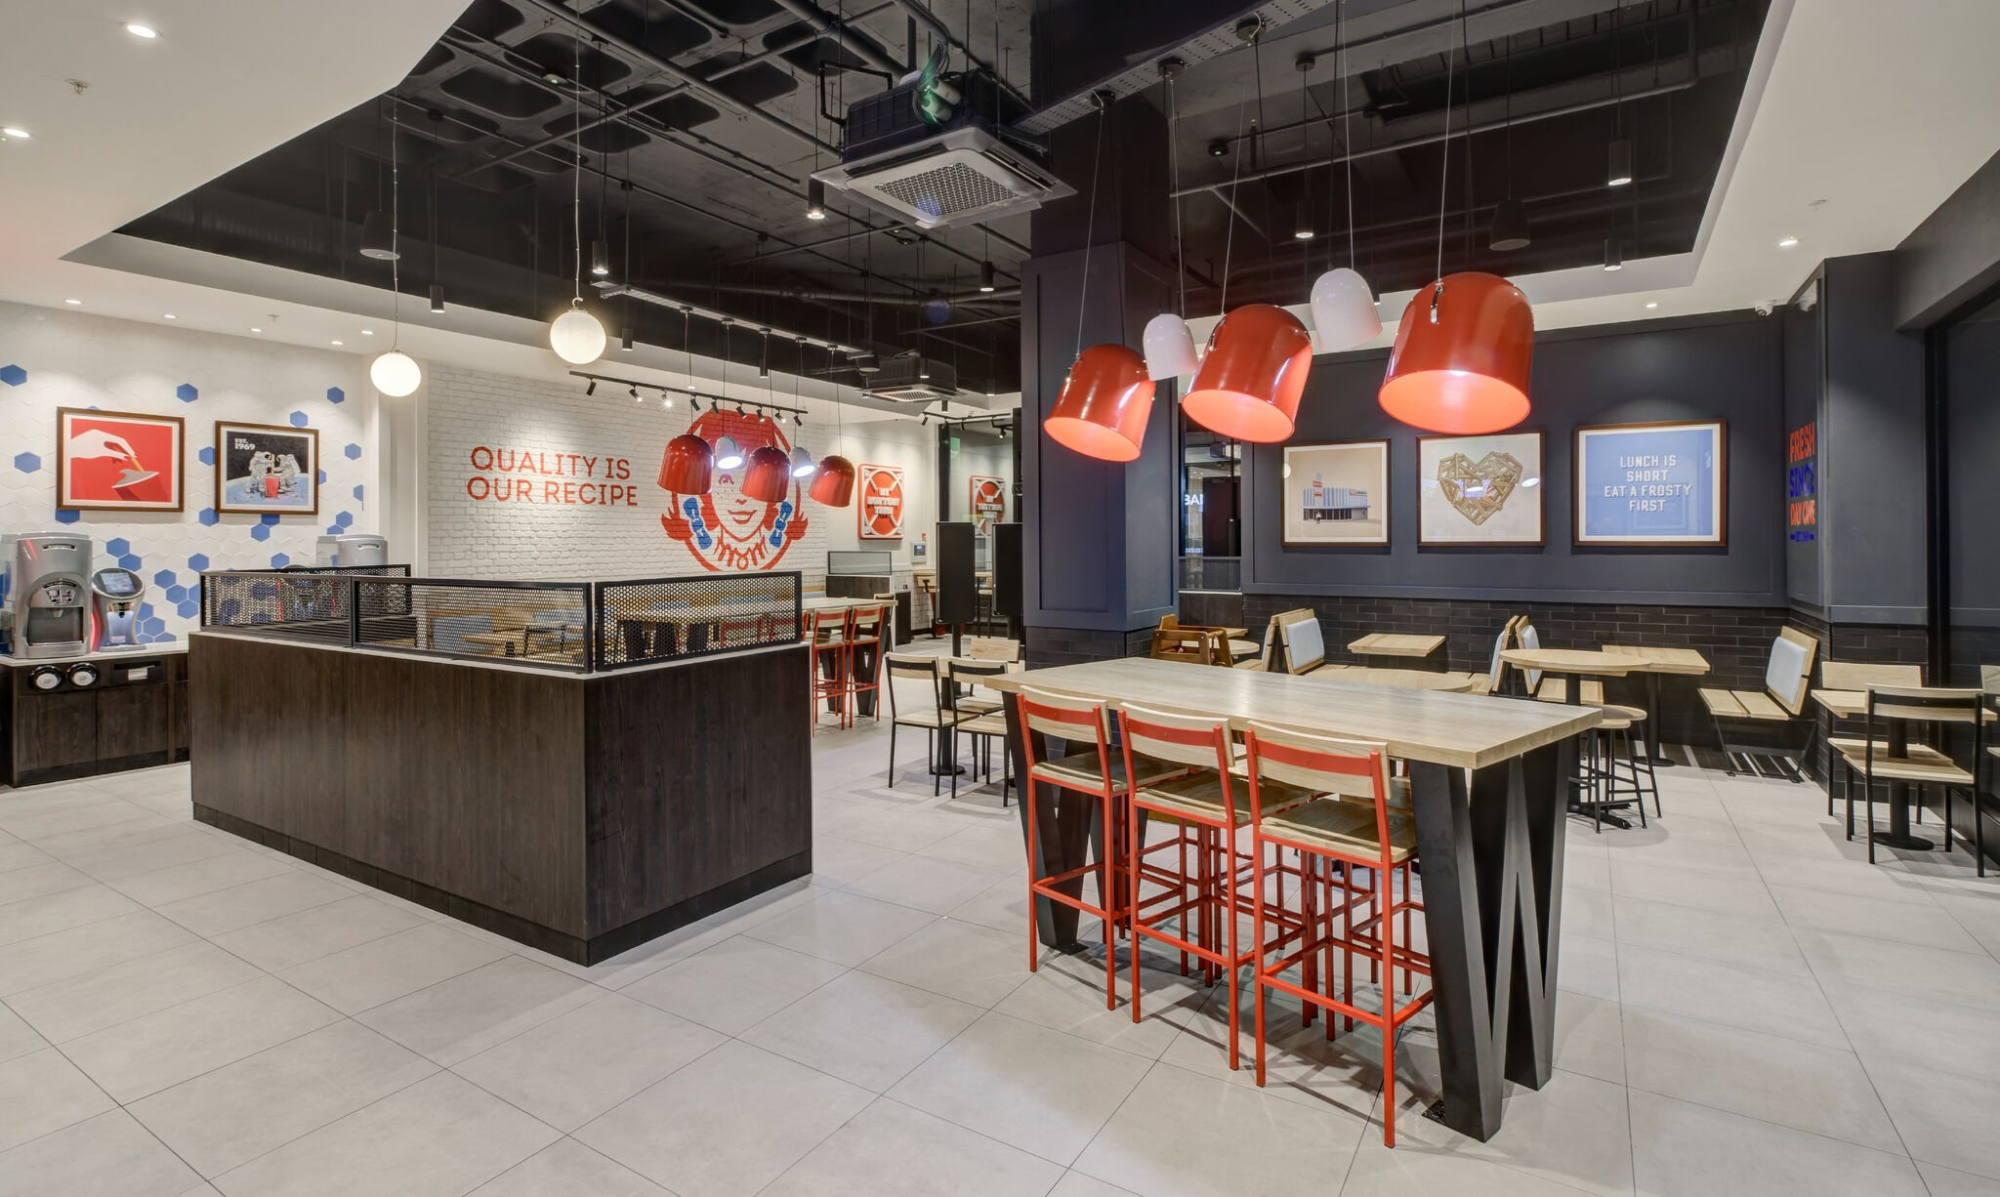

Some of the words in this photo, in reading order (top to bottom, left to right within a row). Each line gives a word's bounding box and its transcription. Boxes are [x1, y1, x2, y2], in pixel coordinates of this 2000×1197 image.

[234, 443, 256, 451] 1969
[1789, 421, 1815, 463] FRESH
[470, 445, 597, 477] QUALITY
[605, 457, 631, 480] IS
[1620, 455, 1660, 468] LUNCH
[1664, 454, 1677, 467] IS
[1626, 469, 1669, 483] SHORT
[467, 476, 533, 503] OUR
[544, 480, 638, 506] RECIPE
[1604, 485, 1627, 498] EAT
[1630, 485, 1637, 498] A
[1641, 484, 1693, 497] FROSTY
[1629, 499, 1667, 512] FIRST
